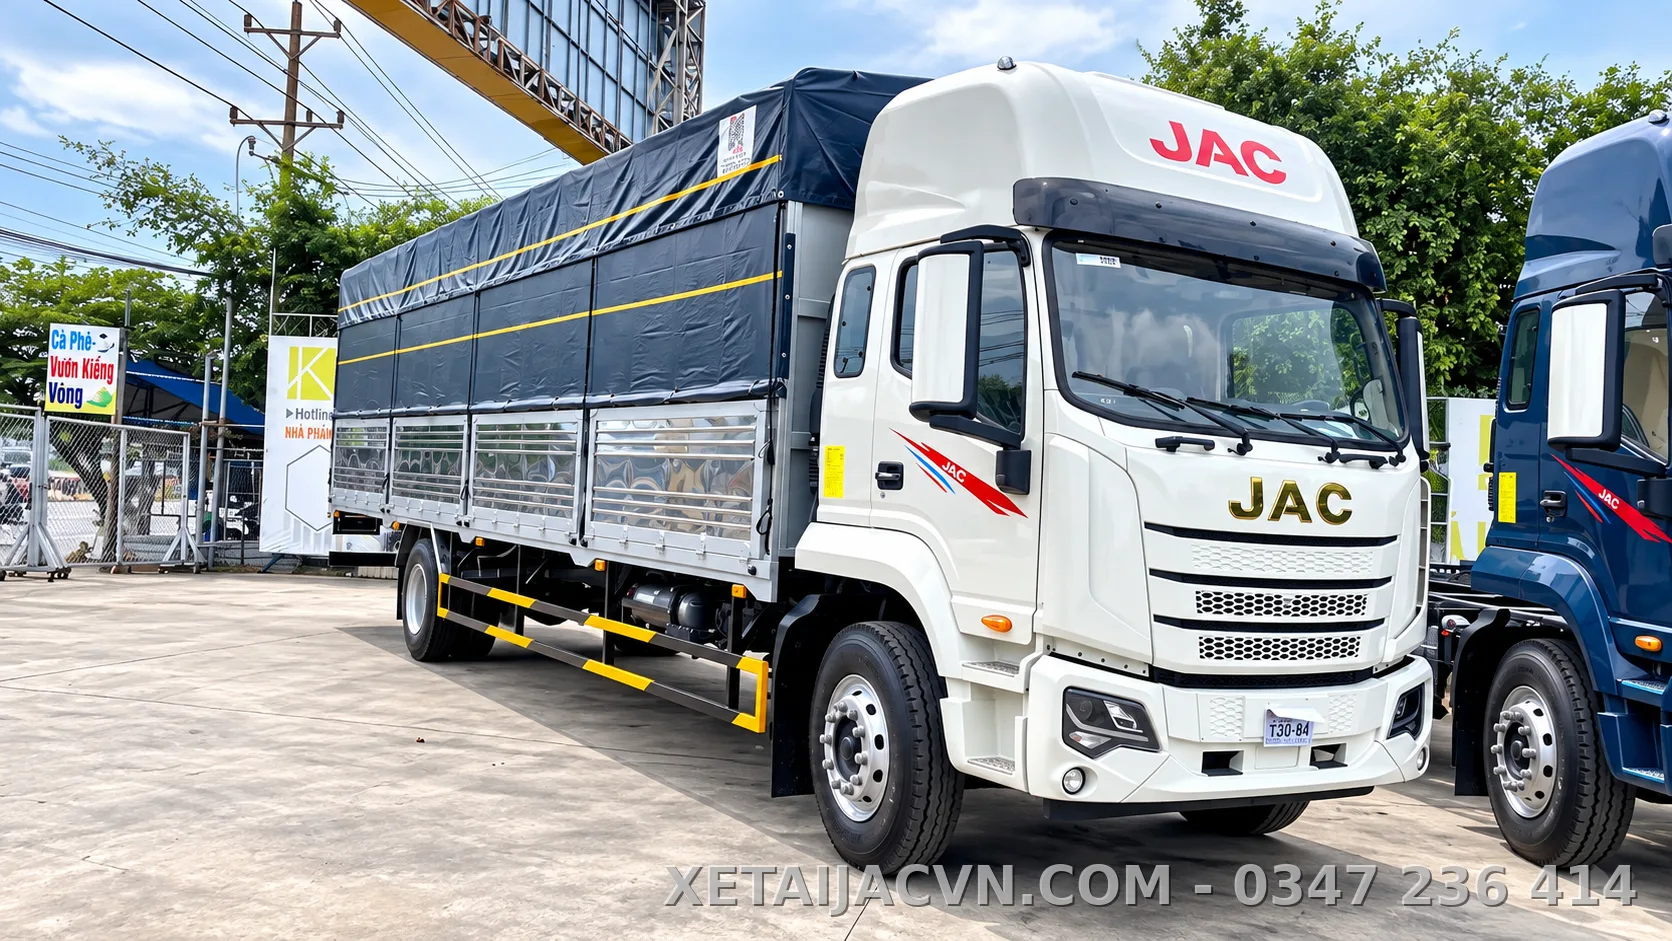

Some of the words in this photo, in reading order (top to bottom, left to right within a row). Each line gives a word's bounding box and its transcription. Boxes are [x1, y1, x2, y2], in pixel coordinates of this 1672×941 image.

[1149, 120, 1287, 185] JAC
[295, 407, 333, 421] Hotline
[941, 461, 968, 483] JAC
[1227, 476, 1353, 526] JAC
[1598, 489, 1620, 510] JAC
[1269, 720, 1310, 738] T30-84
